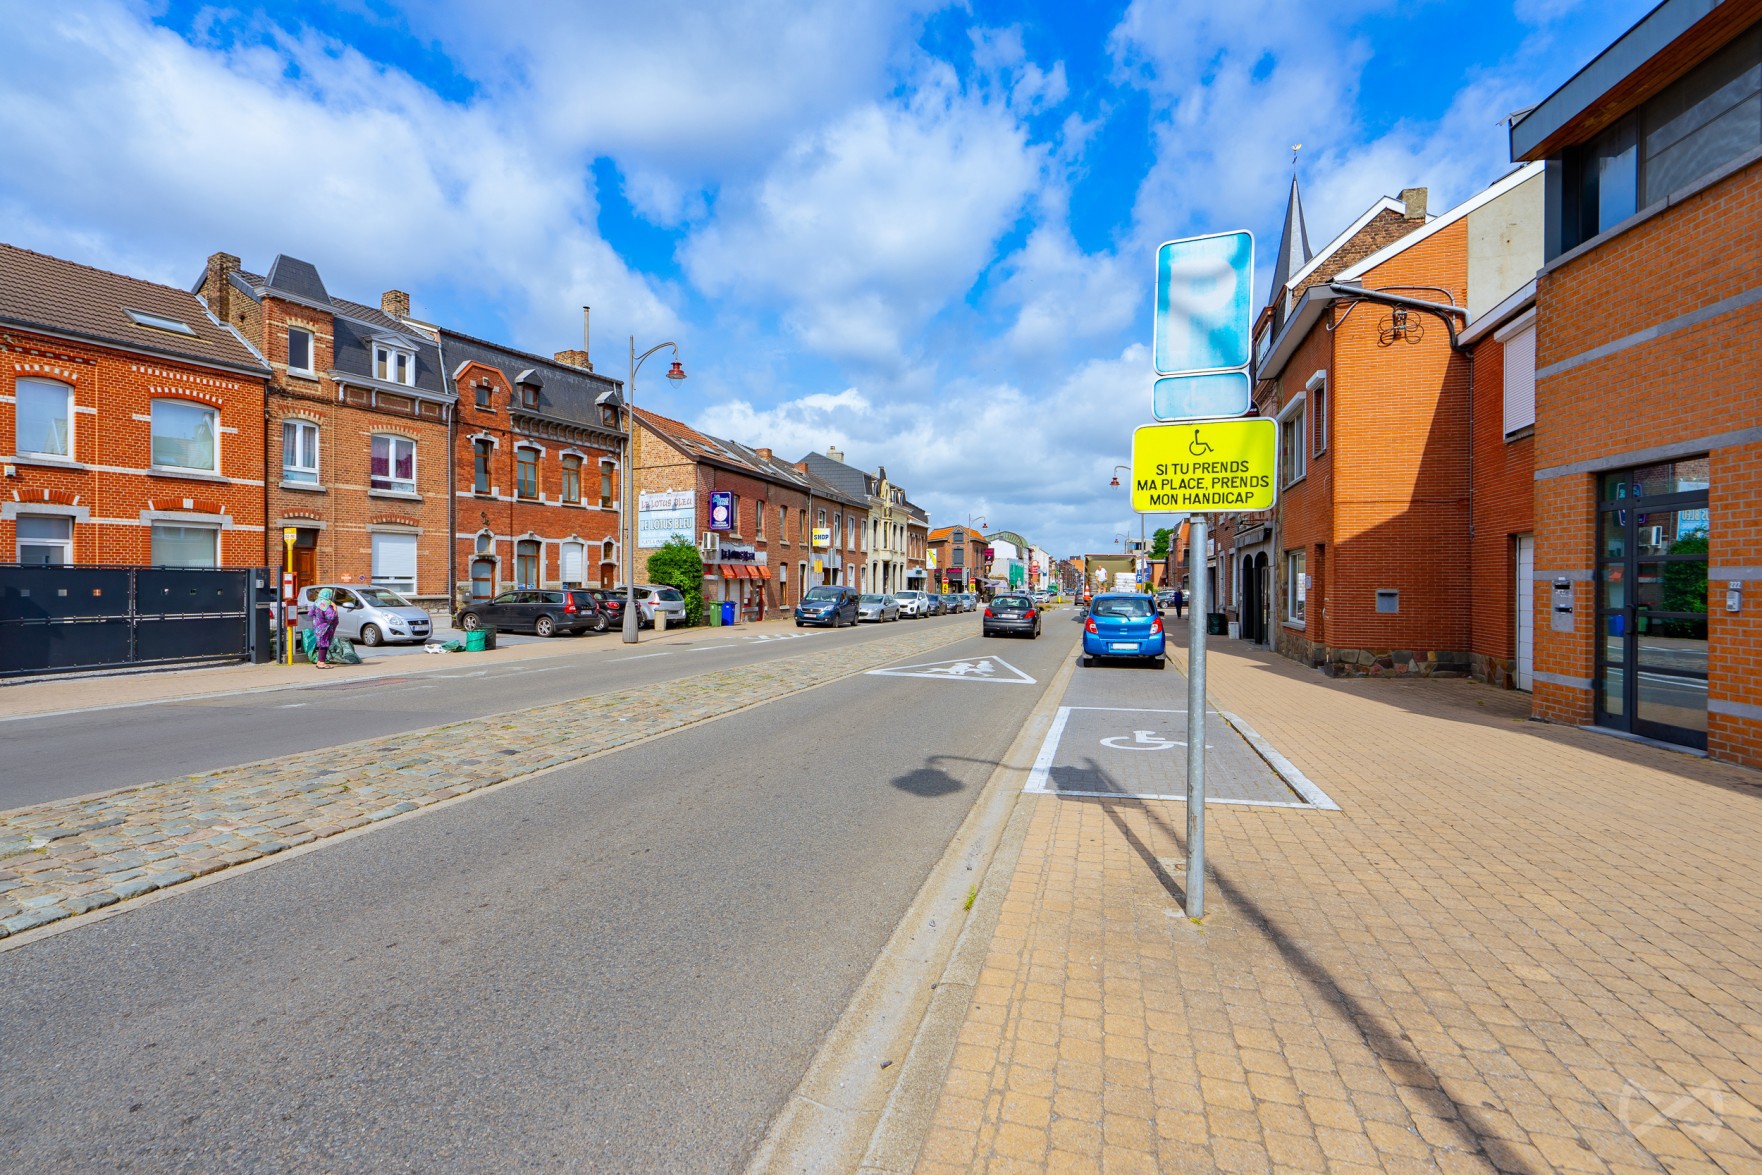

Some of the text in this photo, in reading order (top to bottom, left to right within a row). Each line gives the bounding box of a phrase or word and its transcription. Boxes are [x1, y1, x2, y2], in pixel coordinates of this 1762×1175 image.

[1156, 460, 1249, 476] SI TU PRENDS
[1137, 475, 1269, 491] MA PLACE, PRENDS
[1150, 491, 1254, 506] MON HANDICAP
[650, 518, 672, 530] LOTUS
[674, 517, 692, 529] BLEU
